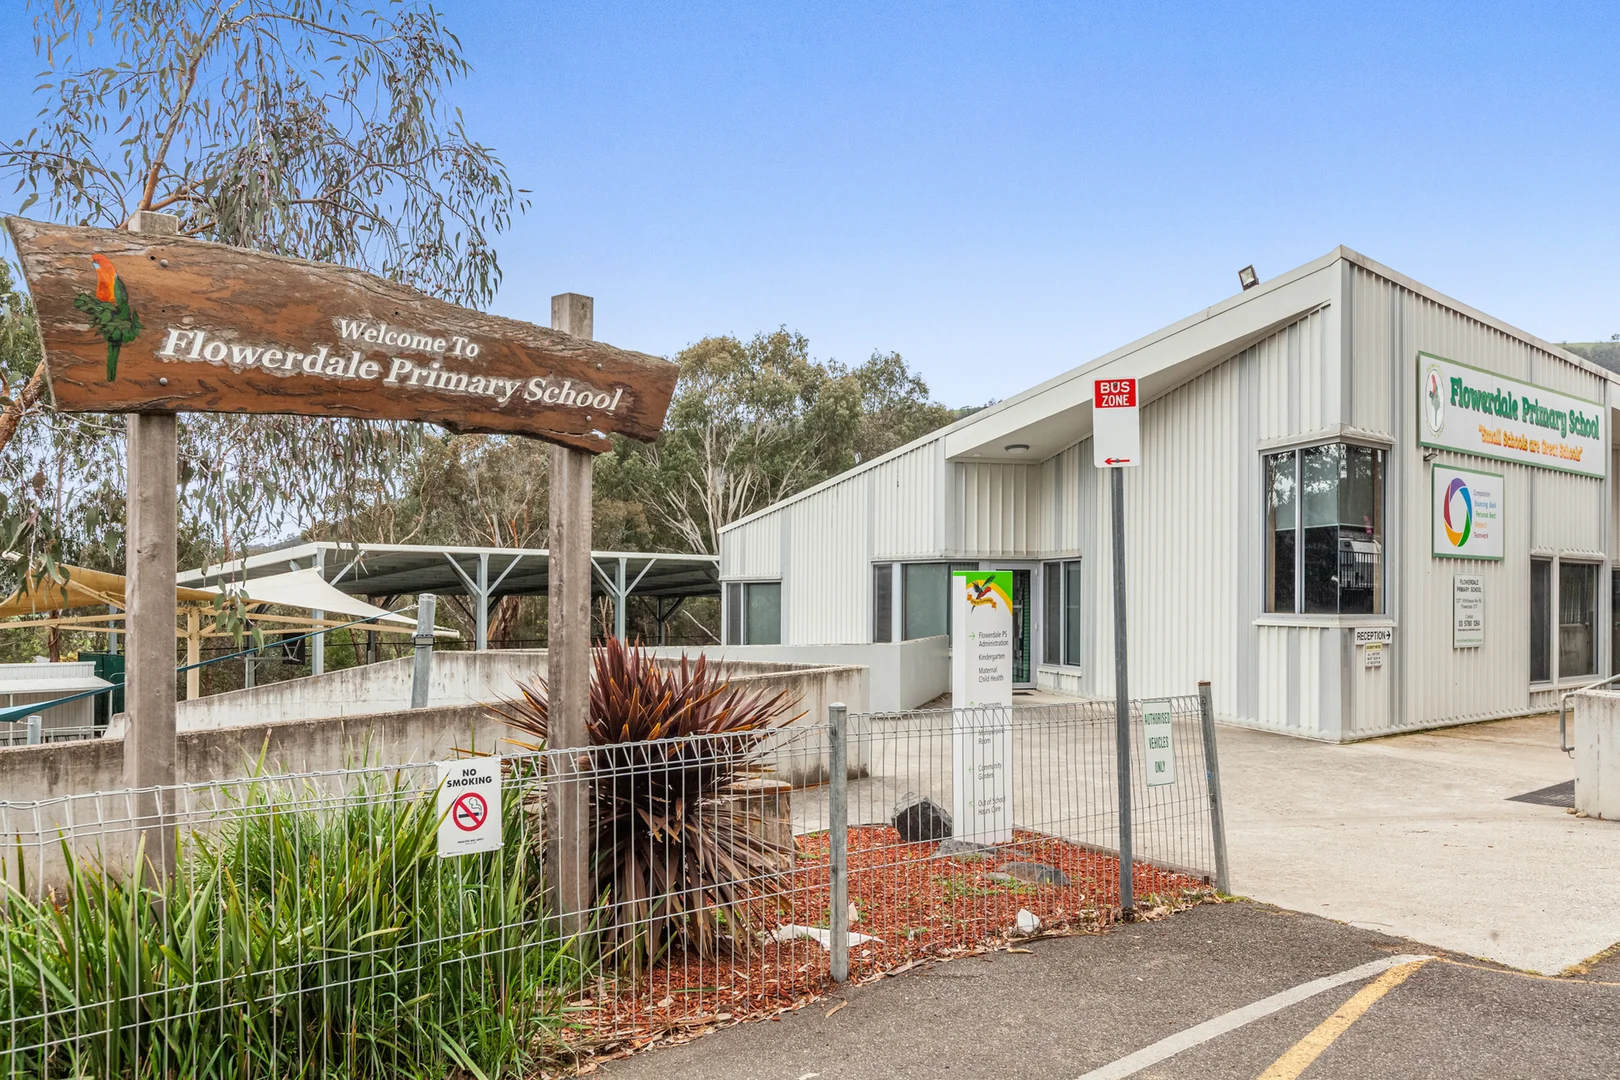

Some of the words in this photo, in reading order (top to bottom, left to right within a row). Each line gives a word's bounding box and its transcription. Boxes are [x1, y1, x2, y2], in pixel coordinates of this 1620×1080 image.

[339, 318, 446, 352] Welcome
[452, 335, 479, 358] To
[160, 327, 379, 380] Flowerdale
[384, 357, 522, 403] Primary
[523, 377, 623, 411] School
[1100, 381, 1130, 394] BUS
[1101, 394, 1130, 407] ZONE
[1450, 376, 1518, 421] Flowerdale
[1521, 396, 1567, 439] Primary
[1569, 409, 1599, 440] School
[1503, 430, 1528, 451] Schools
[1529, 439, 1540, 453] are
[1541, 439, 1558, 457] Great
[1473, 489, 1490, 497] Compassion
[1474, 500, 1488, 509] Bouncing
[1473, 531, 1488, 539] Teamwork
[978, 631, 1001, 639] Flowerdale
[1002, 630, 1008, 638] PS
[1356, 631, 1386, 641] RECEPTION
[978, 639, 1009, 648] Administration
[978, 653, 1006, 662] Kindergarten
[978, 666, 998, 674] Maternal
[978, 675, 990, 683] Child
[990, 674, 1004, 682] Health
[1144, 712, 1170, 726] AUTHORISED
[1148, 736, 1169, 749] VEHICLES
[978, 762, 1002, 772] Community
[1154, 760, 1165, 773] ONLY
[462, 768, 477, 777] NO
[978, 772, 994, 781] Garden
[446, 776, 492, 788] SMOKING
[978, 799, 986, 807] Out
[987, 798, 992, 806] of
[992, 796, 1005, 805] School
[978, 807, 991, 815] Hours
[991, 806, 1001, 814] Care
